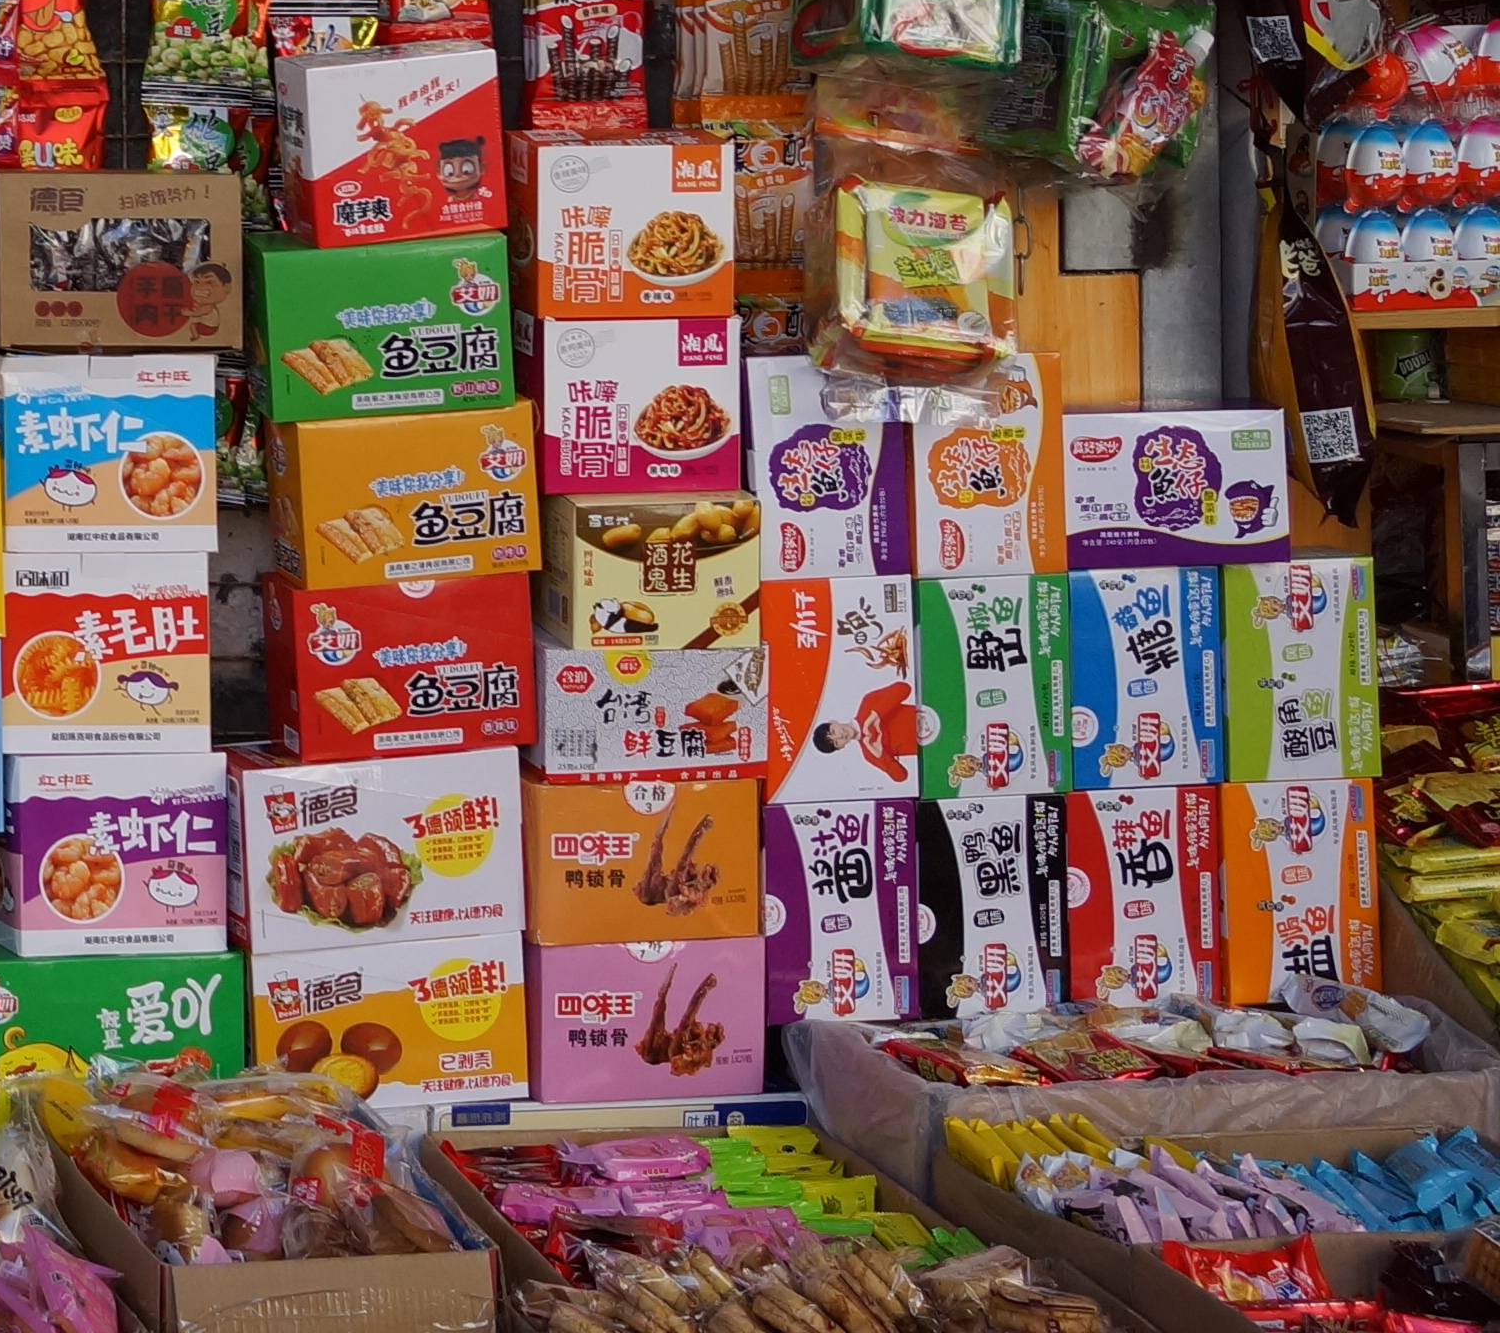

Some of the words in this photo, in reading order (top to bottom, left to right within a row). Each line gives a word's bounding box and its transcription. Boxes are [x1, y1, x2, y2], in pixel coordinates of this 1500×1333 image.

[333, 196, 391, 226] 魔芋爽
[136, 369, 192, 384] 红中旺
[16, 408, 148, 455] 素虾仁
[73, 606, 205, 661] 素毛肚
[622, 729, 707, 759] 鲜豆腐
[37, 773, 94, 787] 红中旺
[85, 812, 219, 857] 素虾仁
[564, 868, 626, 890] 鸭锁骨
[567, 1028, 630, 1049] 鸭锁骨
